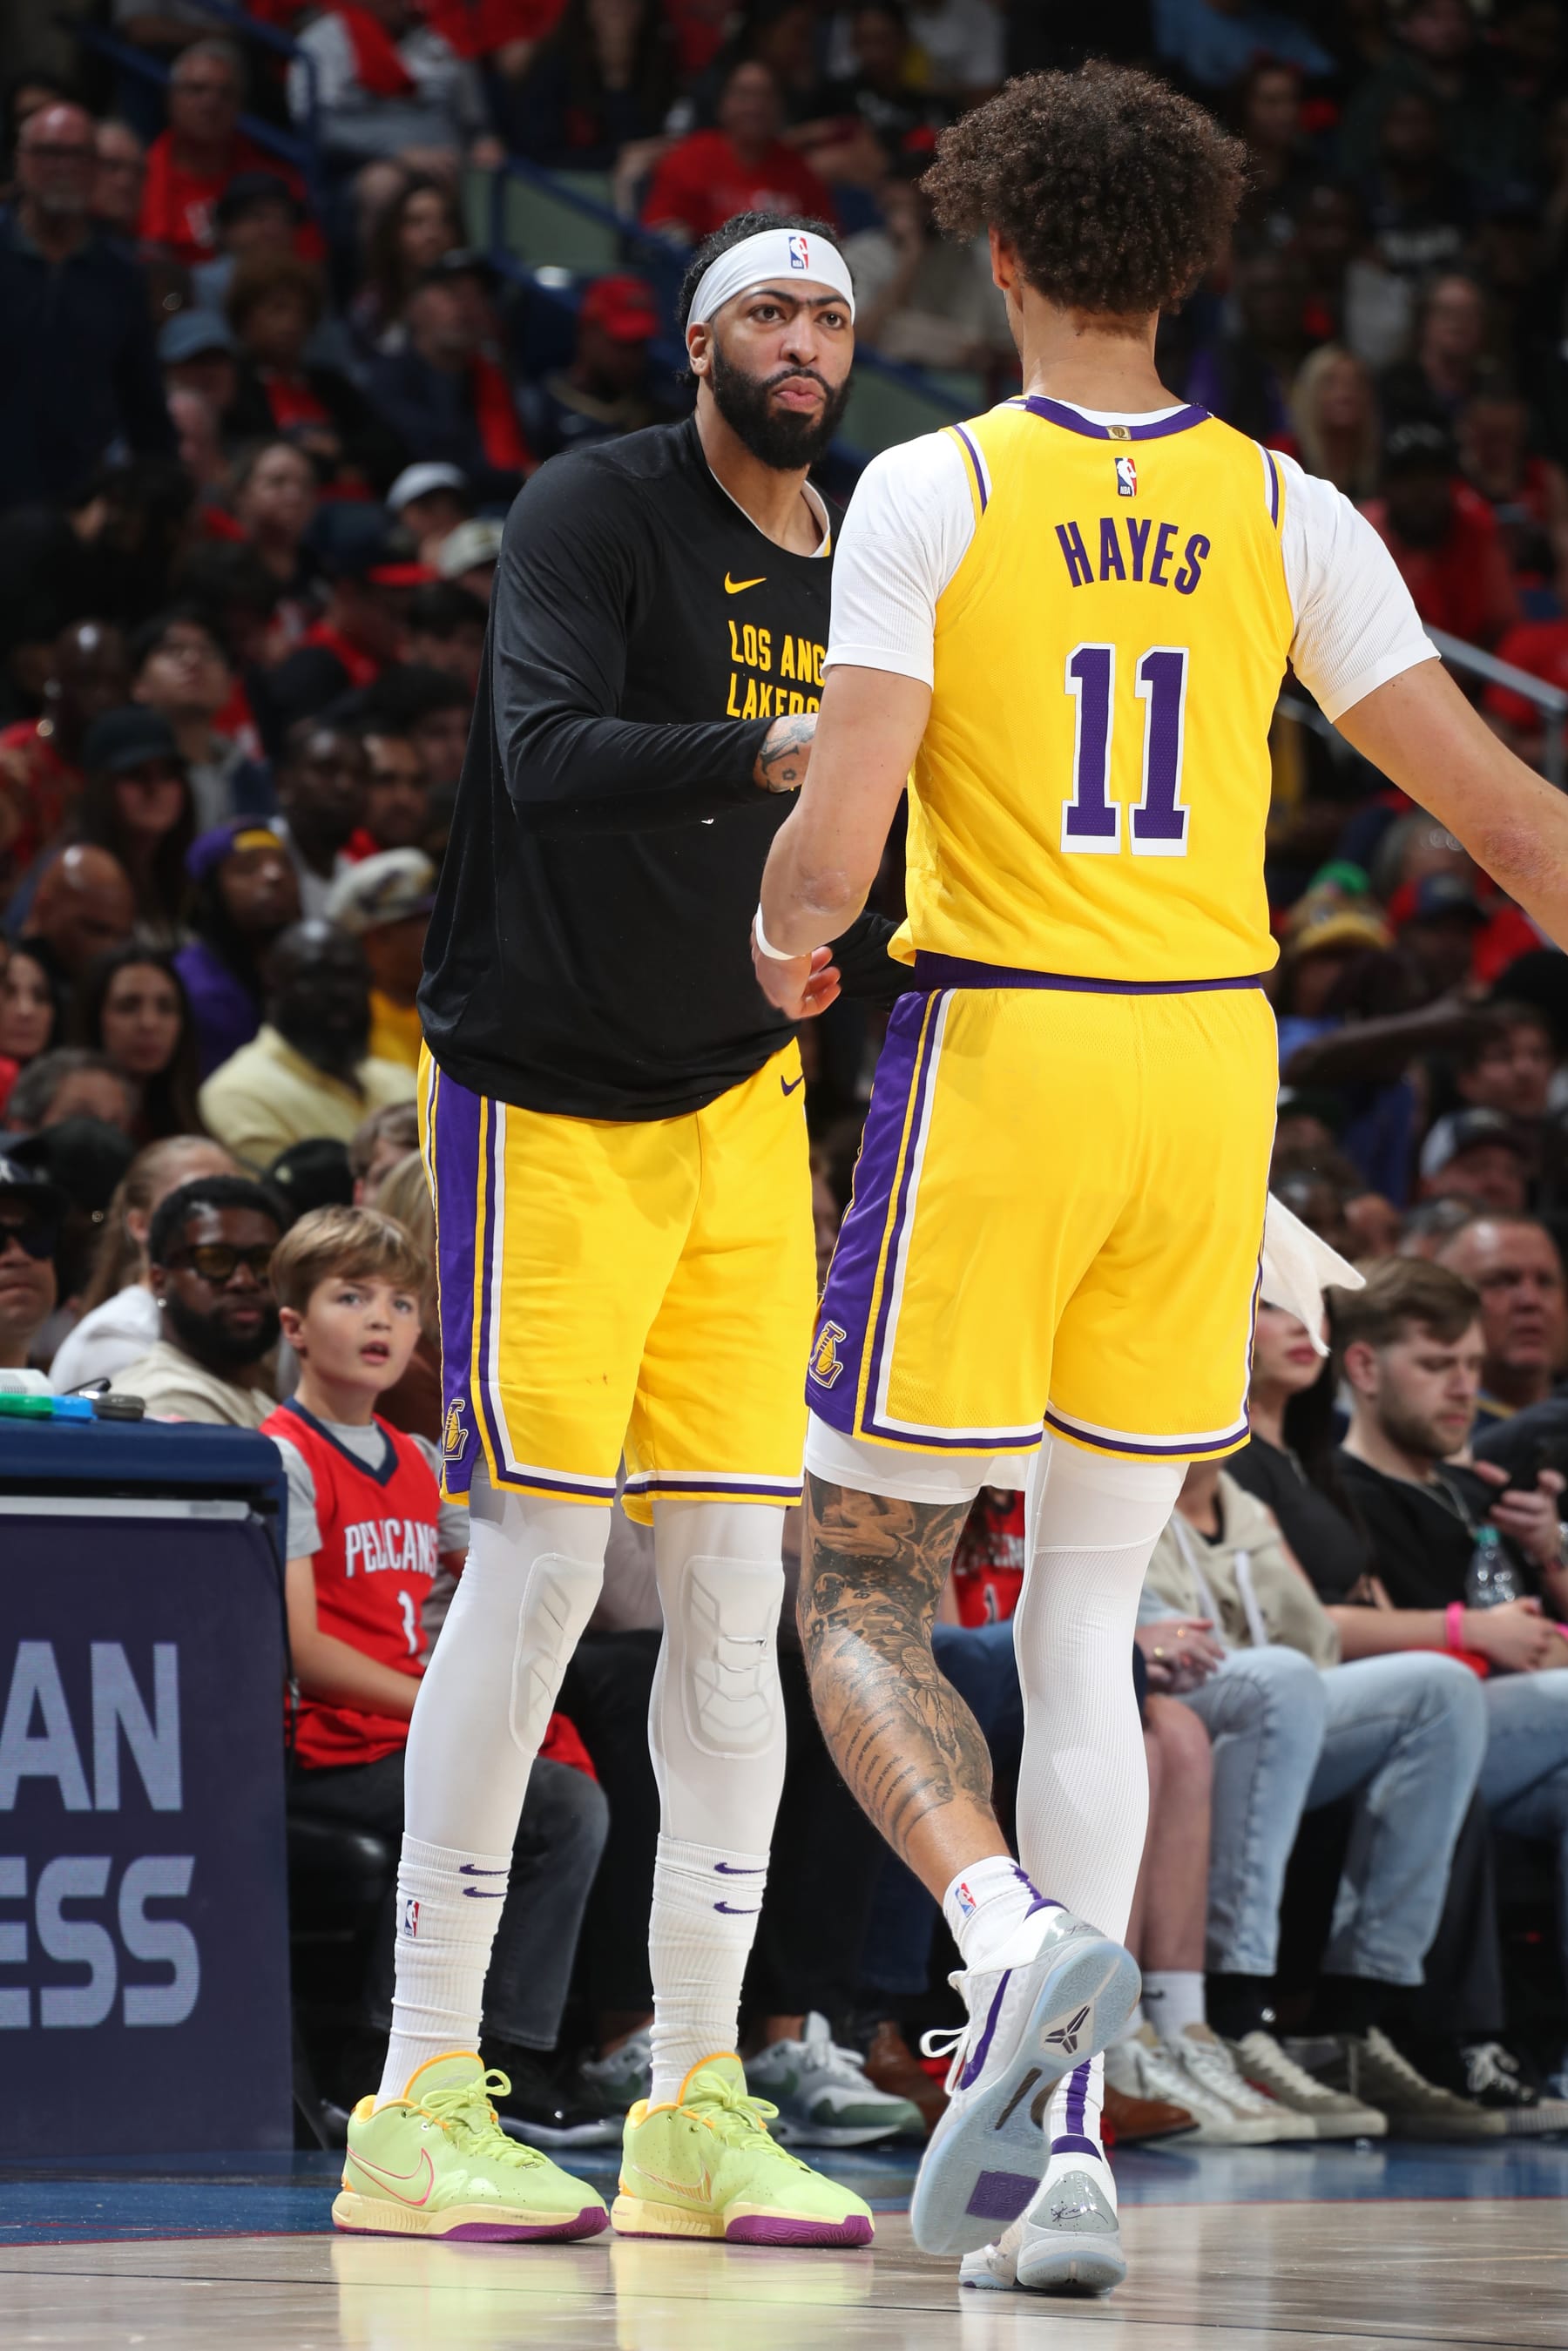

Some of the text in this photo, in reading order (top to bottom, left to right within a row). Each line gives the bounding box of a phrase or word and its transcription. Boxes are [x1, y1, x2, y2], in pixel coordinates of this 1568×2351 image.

[1055, 517, 1211, 595] HAYES
[728, 620, 771, 672] LOS
[1060, 642, 1191, 857] 11
[344, 1518, 438, 1577] PELICANS
[0, 1640, 182, 1811] AN
